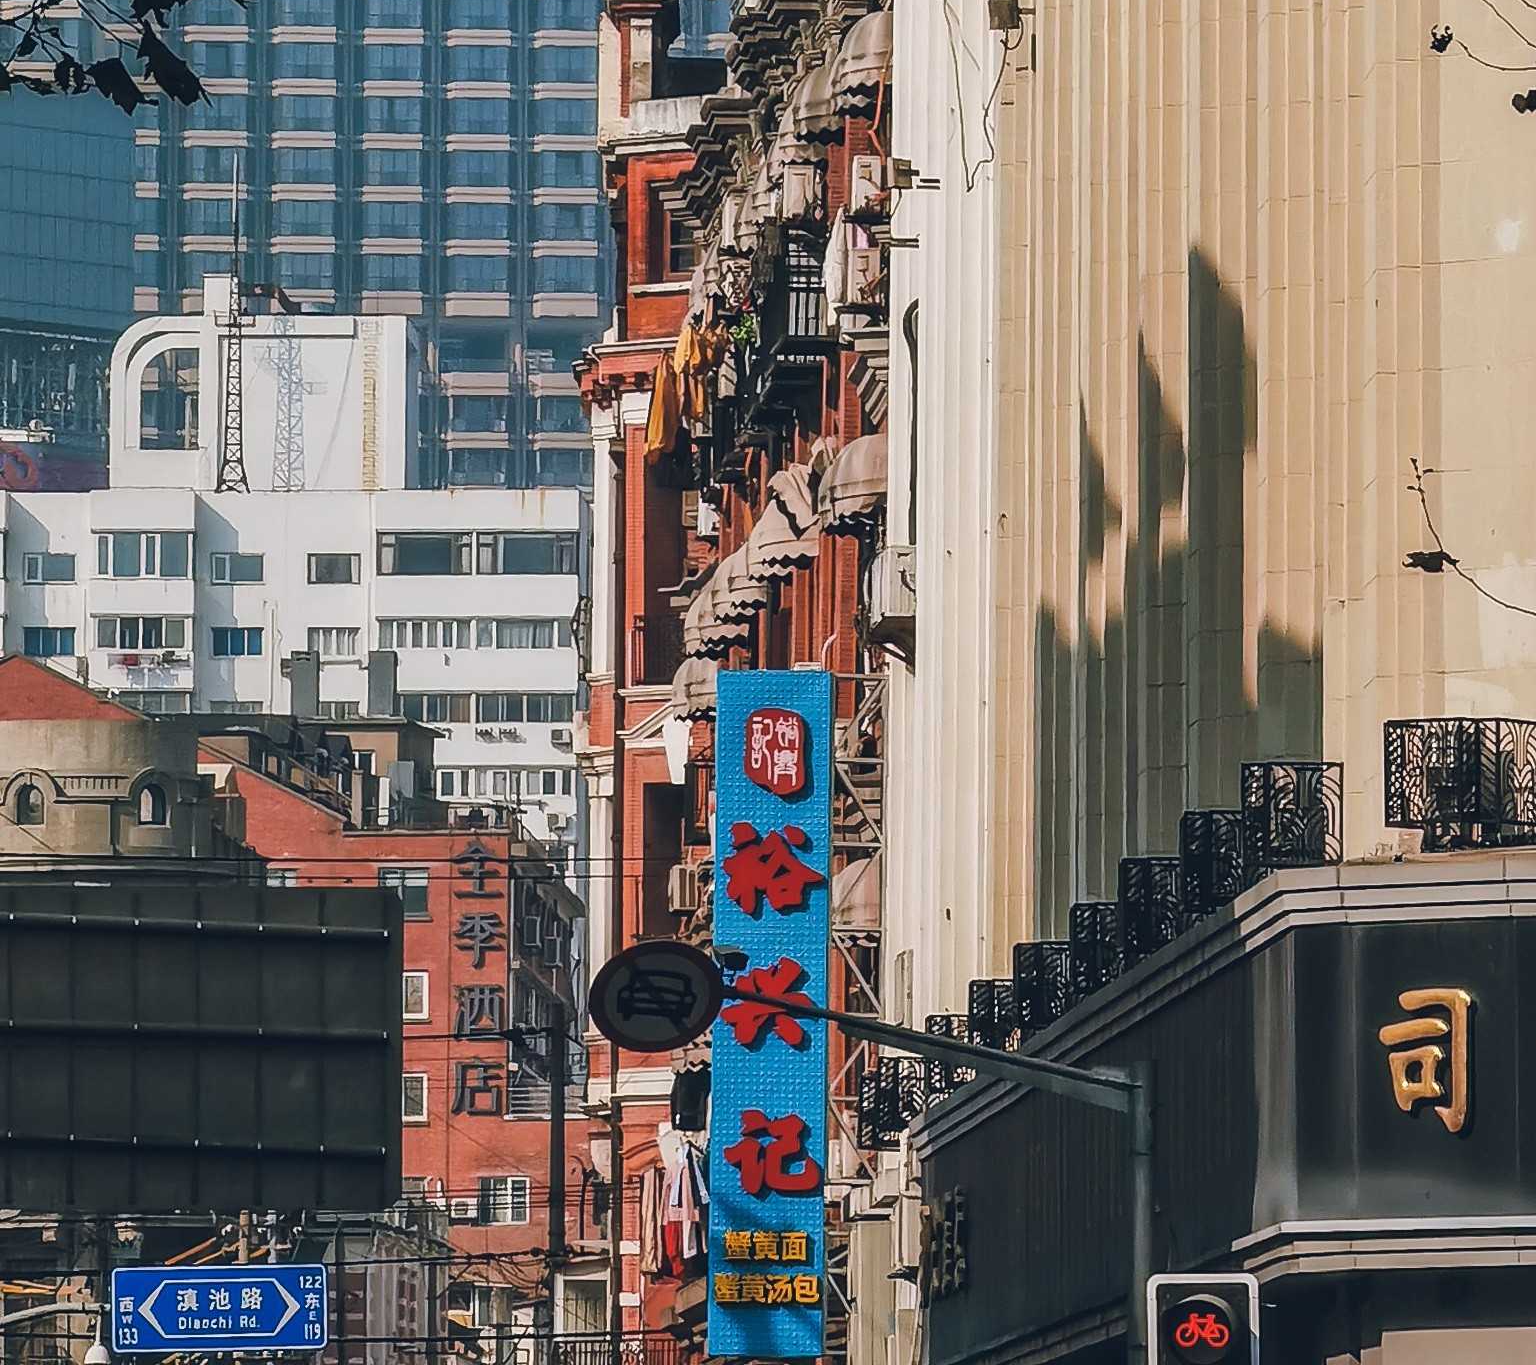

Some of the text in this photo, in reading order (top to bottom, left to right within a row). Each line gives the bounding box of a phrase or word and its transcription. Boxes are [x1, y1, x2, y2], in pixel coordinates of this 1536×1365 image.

[451, 838, 507, 1116] 全季酒店
[722, 820, 825, 1197] 裕兴记
[723, 1229, 808, 1261] 蟹黄面
[299, 1275, 322, 1289] 122
[714, 1272, 820, 1304] 蟹黄汤包
[118, 1296, 135, 1312] 西
[177, 1287, 263, 1311] 滇池路
[304, 1292, 321, 1310] 东
[121, 1314, 133, 1324] W
[178, 1316, 260, 1329] Dianchi Rd.
[308, 1311, 317, 1321] E
[119, 1328, 139, 1345] 133
[304, 1323, 321, 1340] 119
